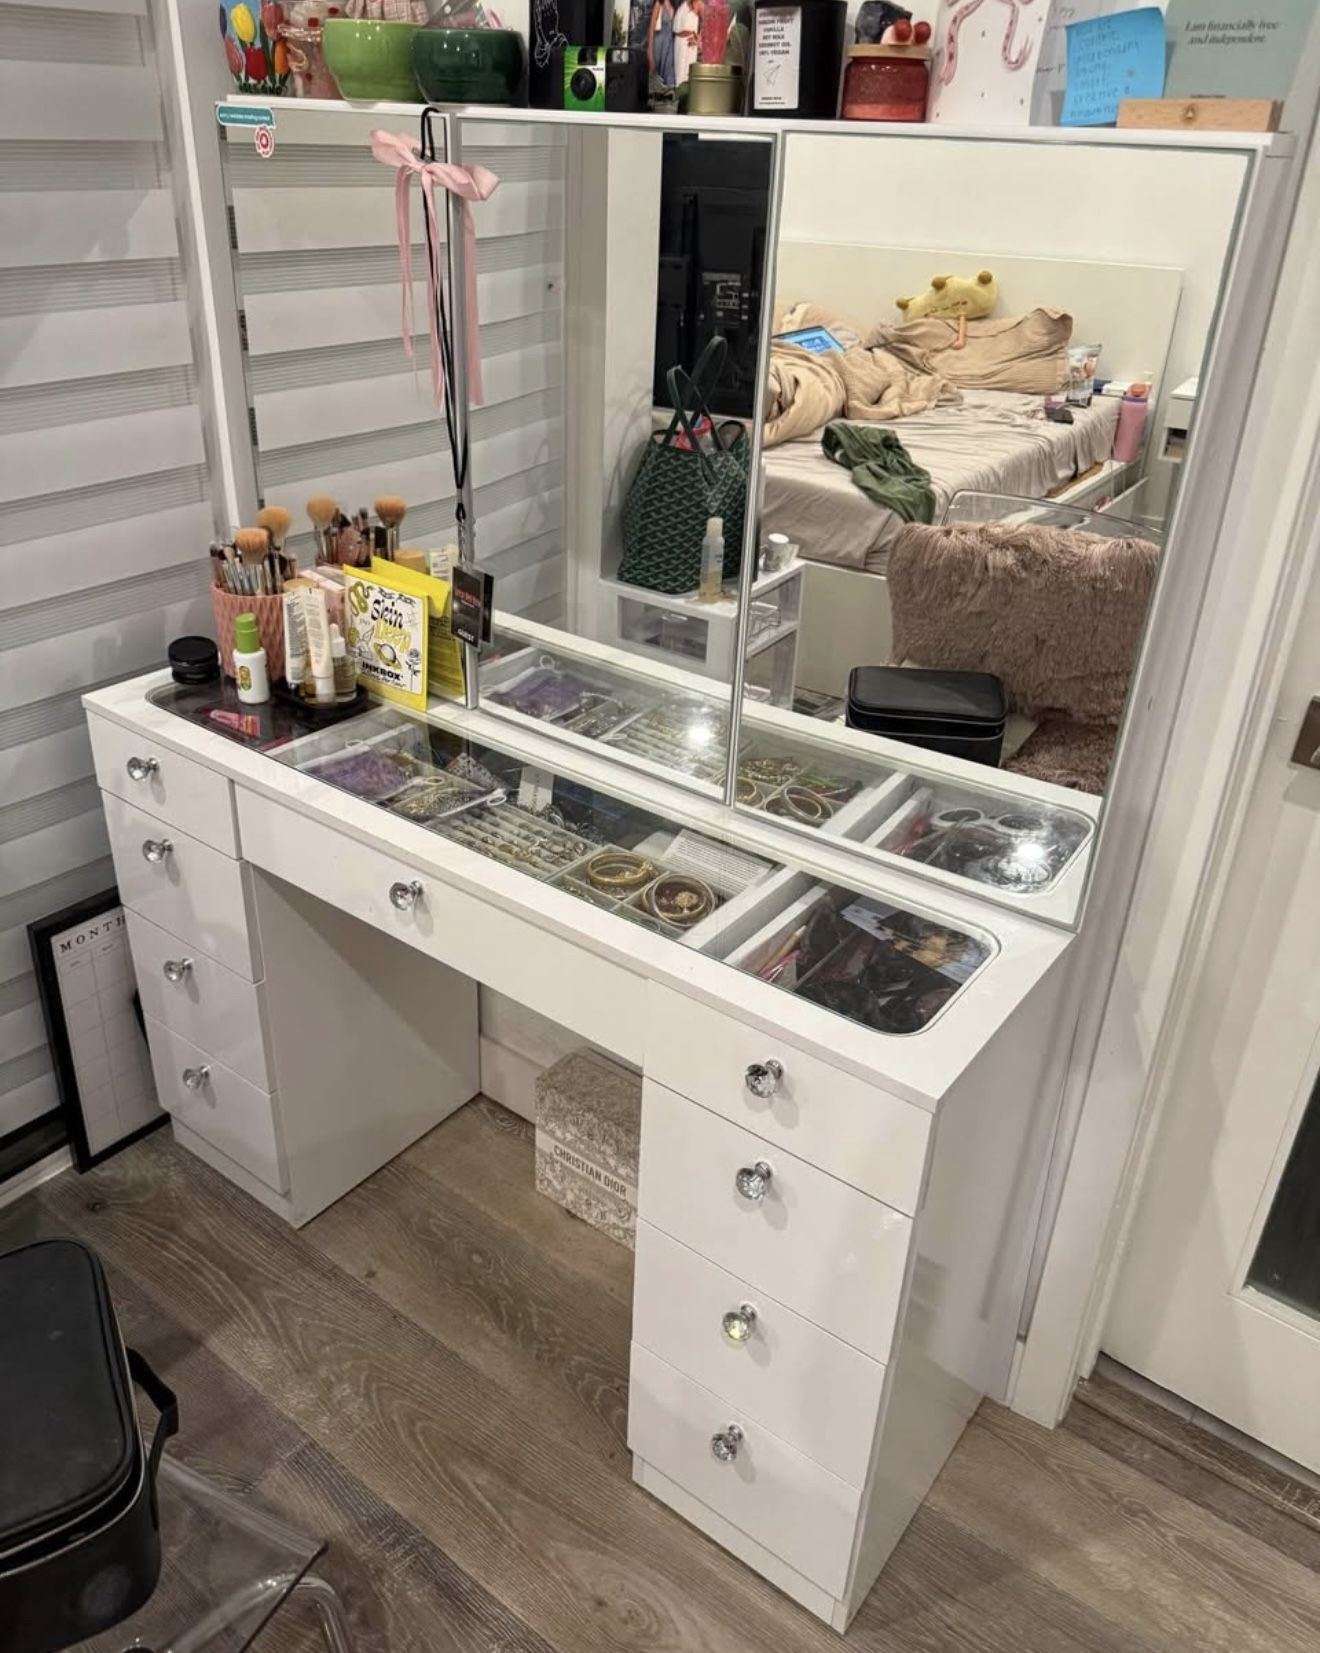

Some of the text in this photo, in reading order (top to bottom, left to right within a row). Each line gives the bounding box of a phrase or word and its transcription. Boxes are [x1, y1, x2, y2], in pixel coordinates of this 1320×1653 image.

[1207, 20, 1255, 33] financially
[1258, 20, 1279, 31] free
[1188, 34, 1208, 45] and
[371, 598, 404, 629] Skin
[361, 660, 402, 681] INKBOX
[553, 1144, 627, 1198] CHRISTIAN DIOR
